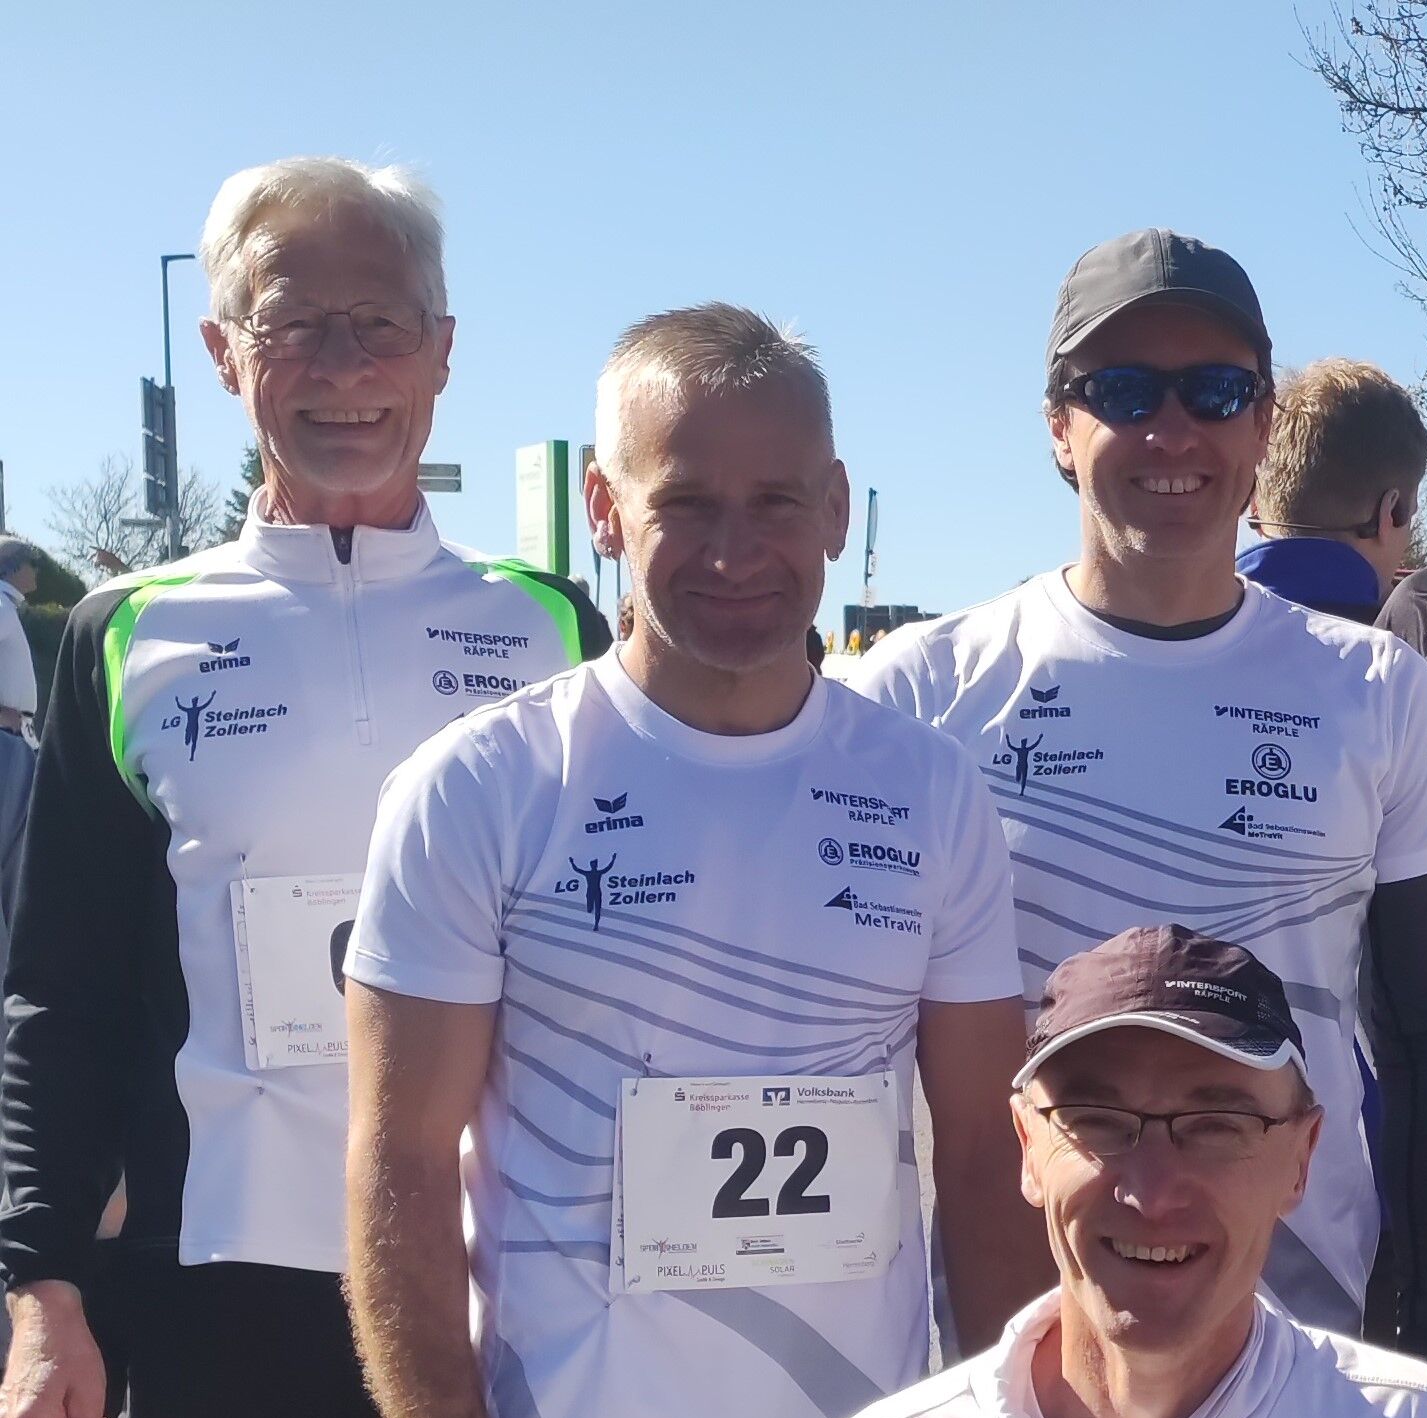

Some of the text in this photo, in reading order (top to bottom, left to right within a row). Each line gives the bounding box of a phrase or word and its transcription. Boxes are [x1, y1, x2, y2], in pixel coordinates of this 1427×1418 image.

[441, 629, 529, 648] INTERSPORT
[464, 645, 509, 659] RÄPPLE
[199, 656, 251, 673] erima
[161, 704, 288, 730] LG Steinlach
[1020, 706, 1071, 719] erima
[1229, 706, 1320, 729] INTERSPORT
[204, 723, 267, 738] Zollern
[1252, 723, 1299, 738] RÄPPLE
[992, 749, 1104, 765] LG Steinlach
[1033, 763, 1087, 776] Zollern
[1225, 779, 1317, 803] EROGLU
[585, 815, 644, 834] erima
[849, 810, 895, 825] RÄPPLE
[848, 843, 920, 867] EROGLU
[554, 870, 695, 893] LG Steinlach
[609, 891, 676, 906] Zollern
[855, 913, 922, 935] MeTraVit
[797, 1087, 854, 1097] Volksbank
[711, 1126, 830, 1219] 22
[657, 1265, 684, 1277] PIXEL
